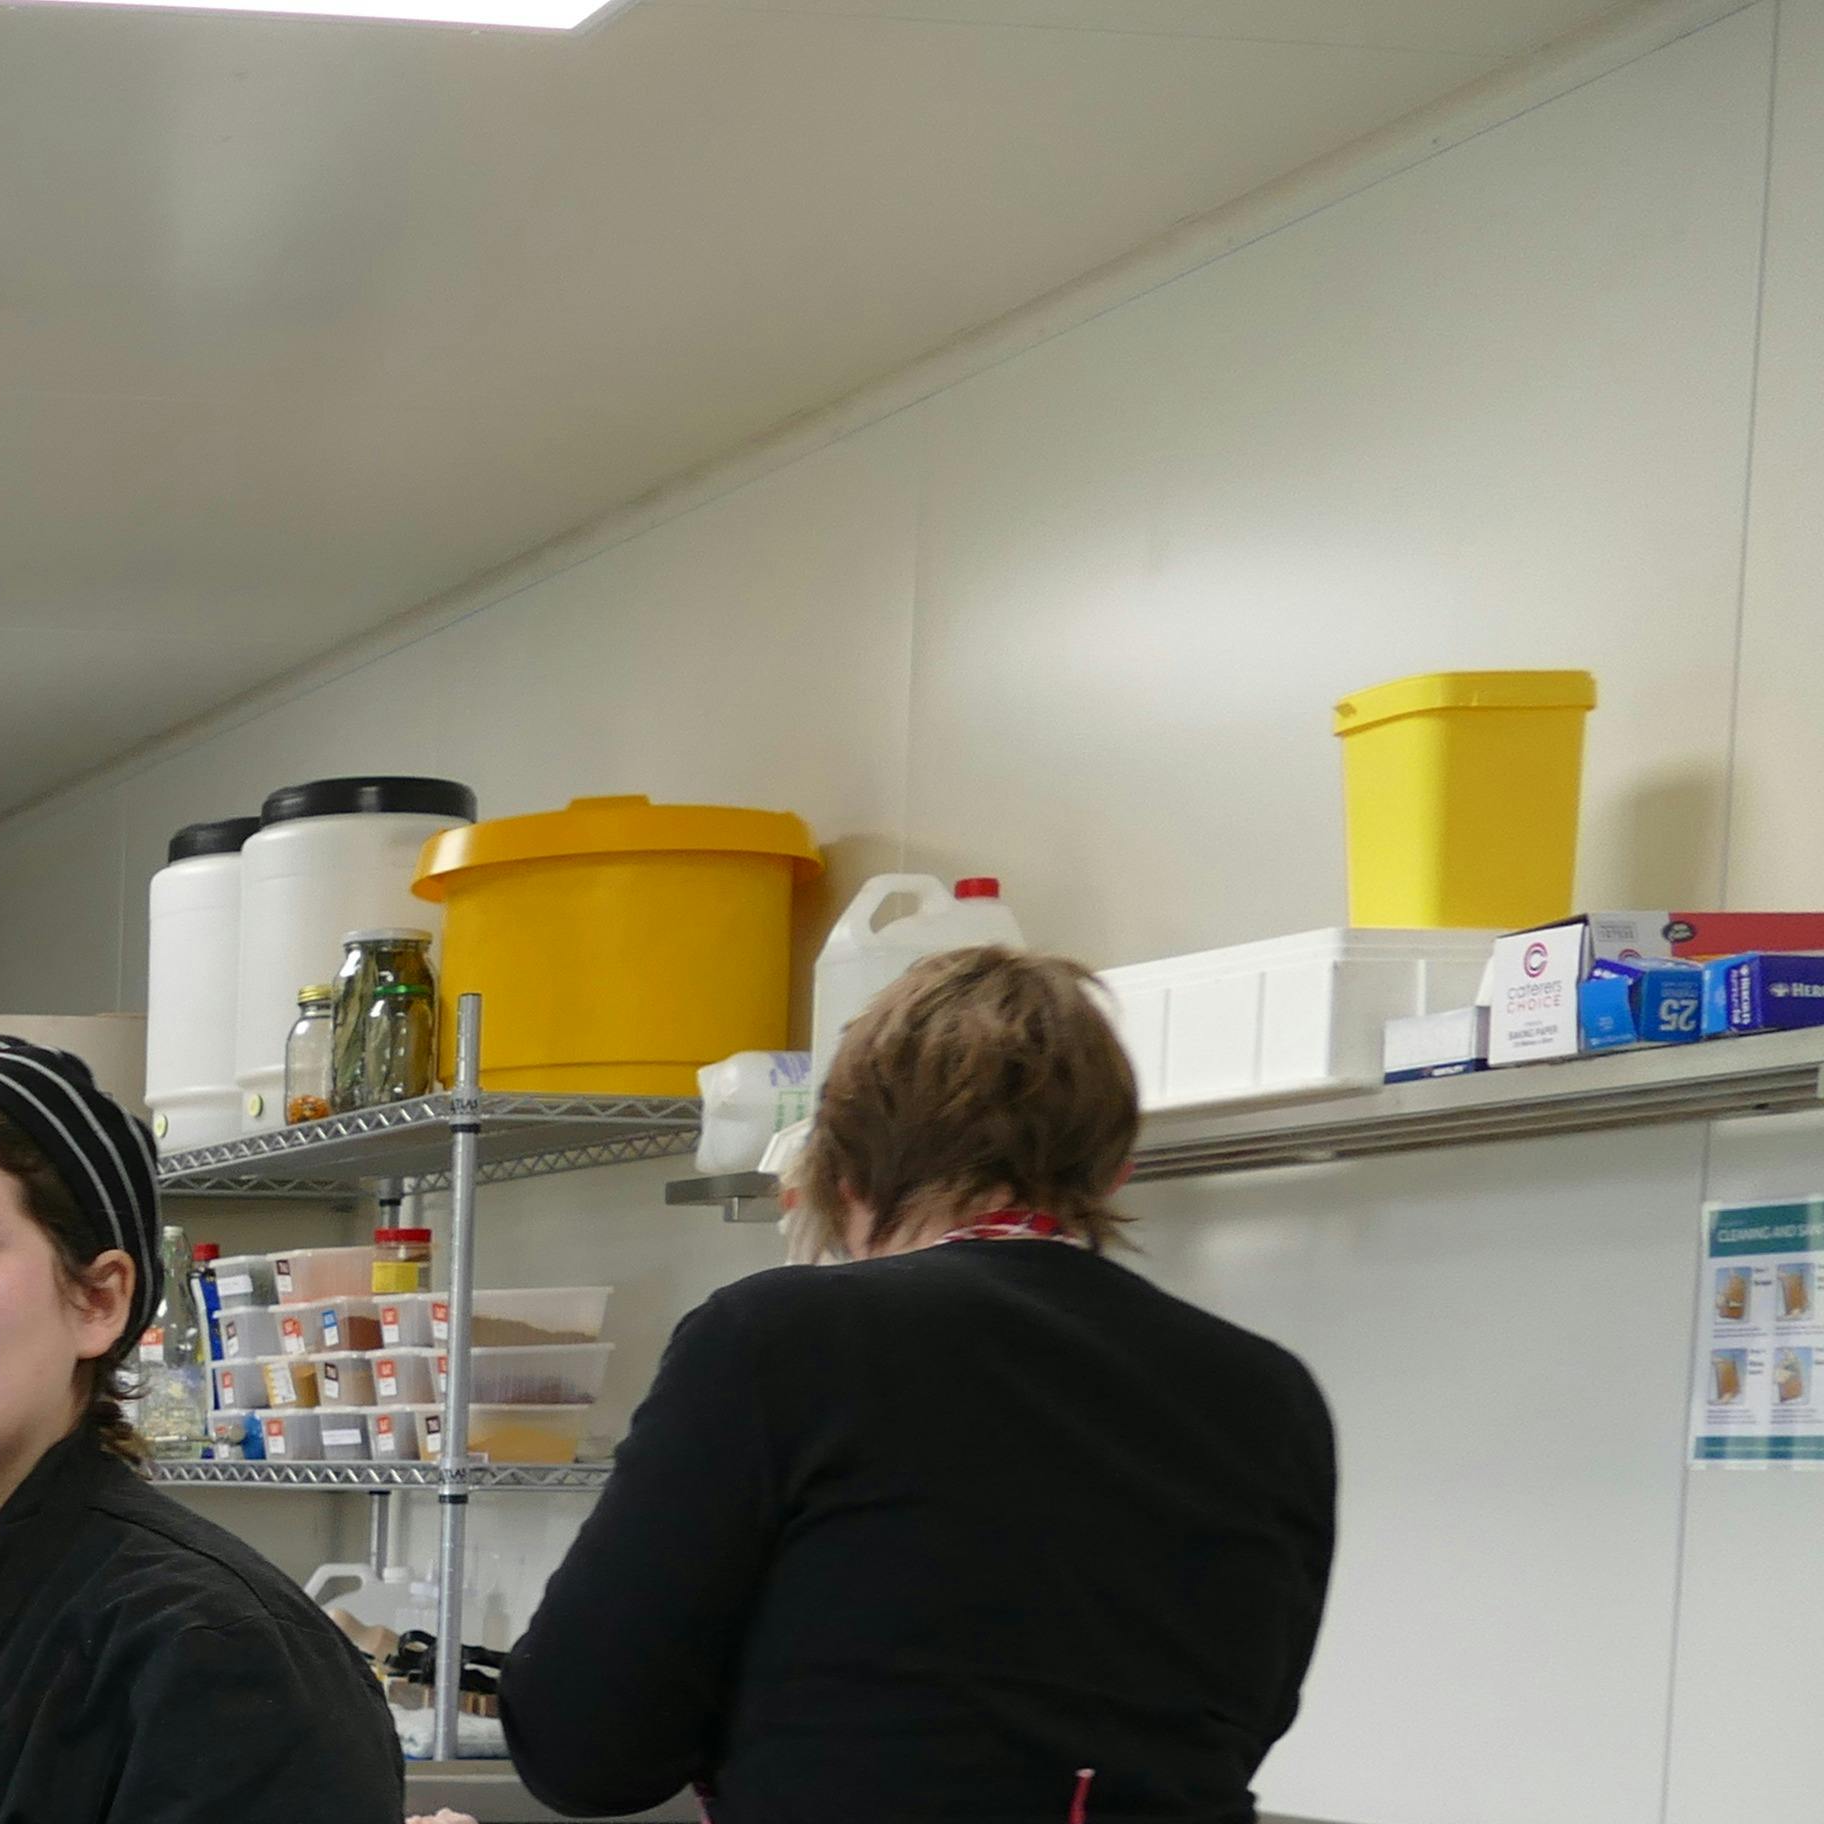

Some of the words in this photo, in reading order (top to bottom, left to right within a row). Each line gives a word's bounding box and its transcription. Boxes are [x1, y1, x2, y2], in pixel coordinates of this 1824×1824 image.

[1508, 980, 1562, 1001] caterers
[1507, 995, 1561, 1014] CHOICE
[1659, 999, 1697, 1033] 25
